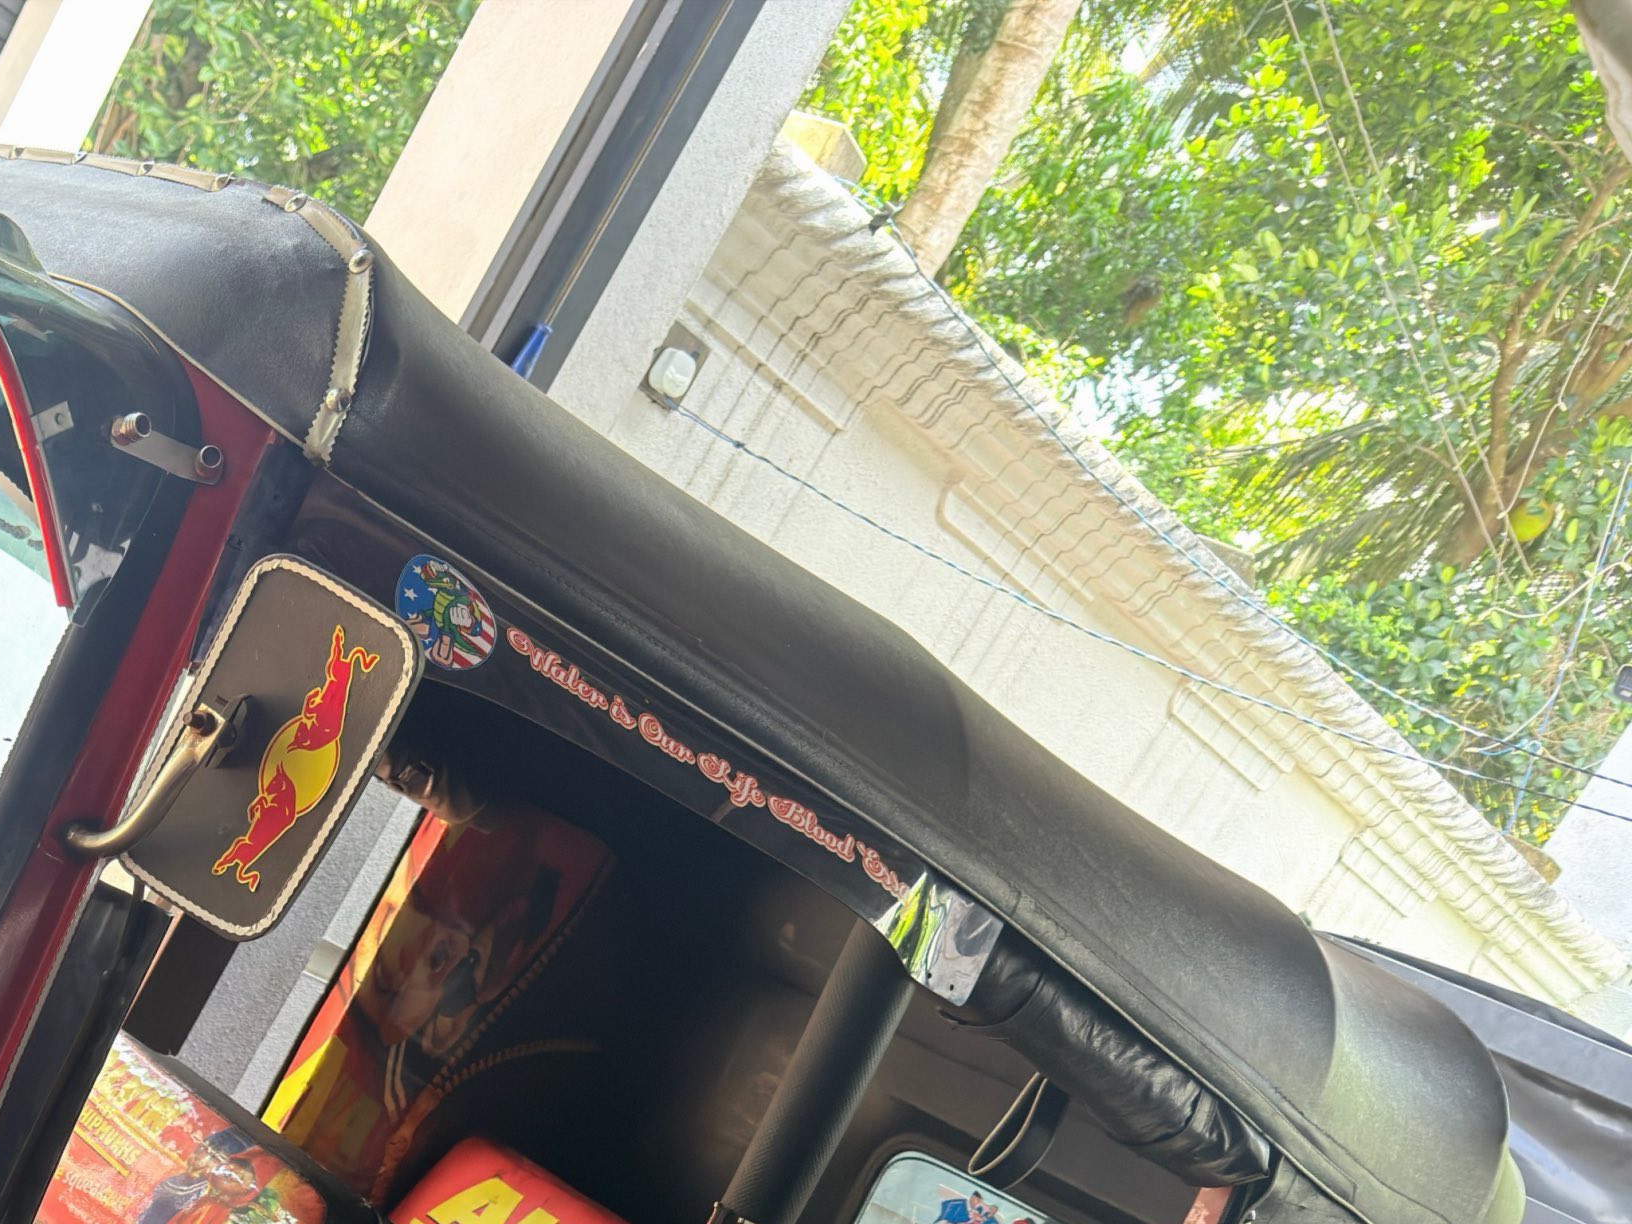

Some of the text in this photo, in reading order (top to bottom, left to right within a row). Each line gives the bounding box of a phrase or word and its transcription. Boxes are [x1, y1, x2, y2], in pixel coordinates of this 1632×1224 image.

[507, 627, 609, 710] Water
[609, 695, 637, 730] is
[638, 713, 696, 765] Our
[697, 752, 766, 808] Life
[768, 796, 856, 863] Blood
